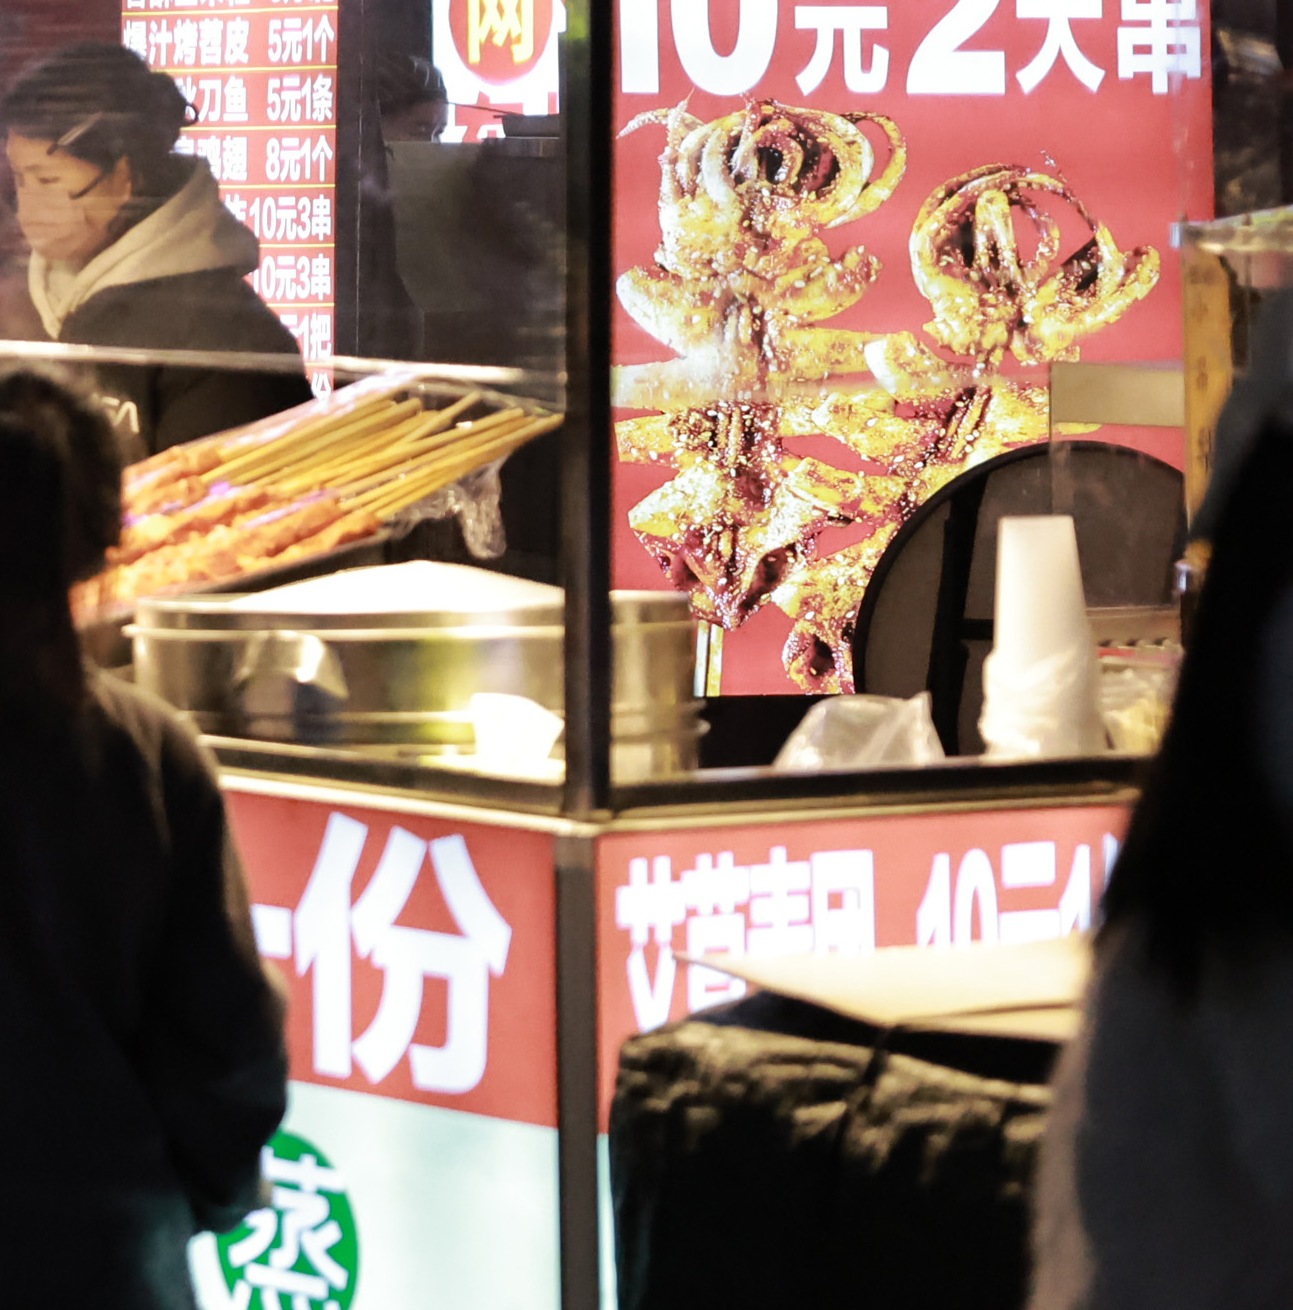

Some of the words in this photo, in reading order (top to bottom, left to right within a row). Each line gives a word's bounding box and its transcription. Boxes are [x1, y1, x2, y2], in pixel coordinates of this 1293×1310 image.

[268, 13, 335, 63] 5元1个
[267, 74, 333, 122] 5元1条
[266, 135, 334, 181] 8元1个
[249, 193, 333, 241] 10元3串
